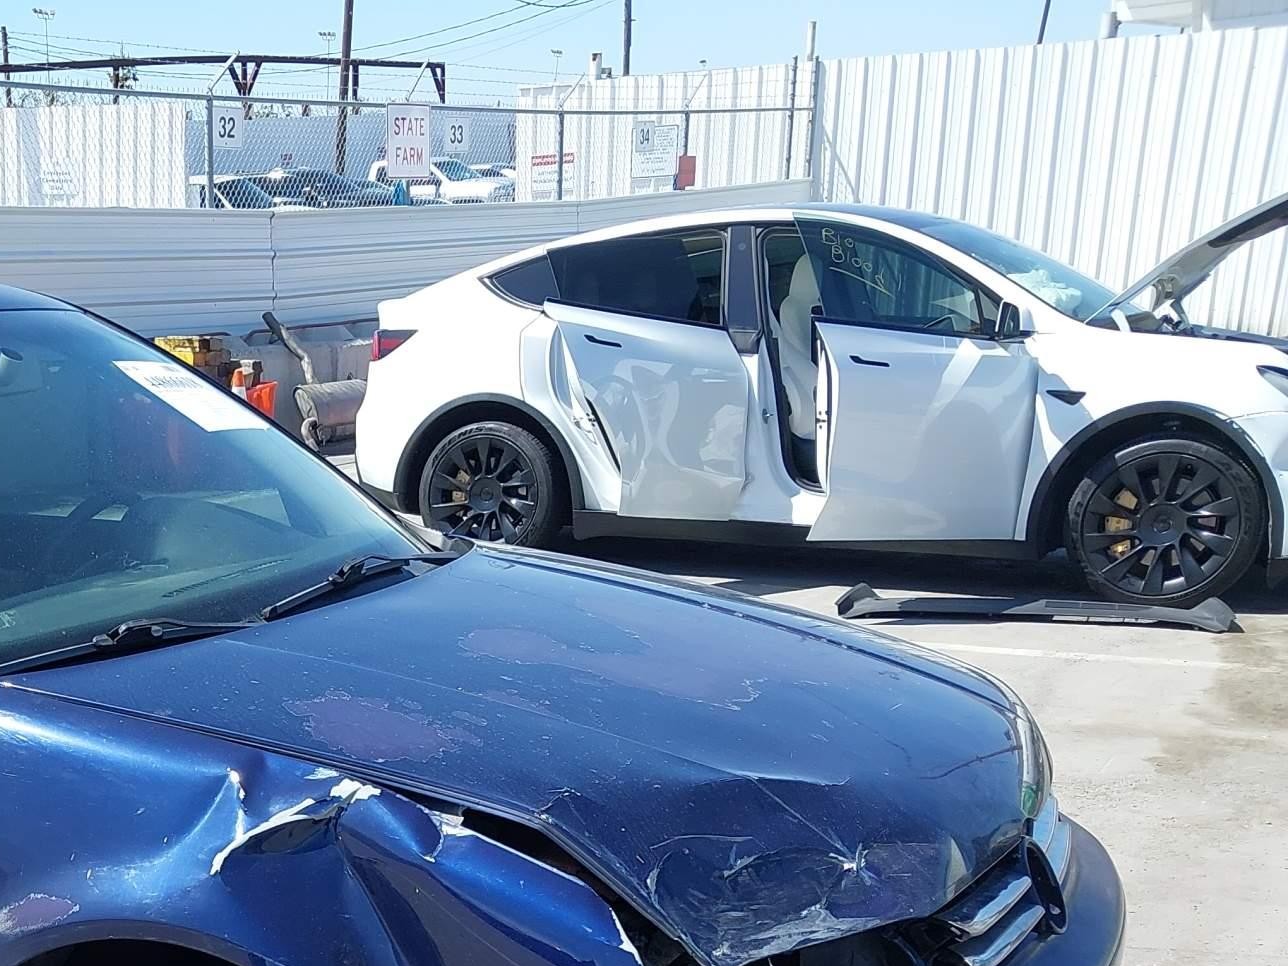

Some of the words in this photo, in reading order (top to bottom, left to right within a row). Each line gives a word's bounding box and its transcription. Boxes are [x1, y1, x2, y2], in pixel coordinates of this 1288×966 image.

[219, 116, 235, 138] 32
[394, 117, 424, 136] STATE
[450, 125, 463, 144] 33
[640, 128, 649, 144] 34
[396, 147, 423, 166] FARM
